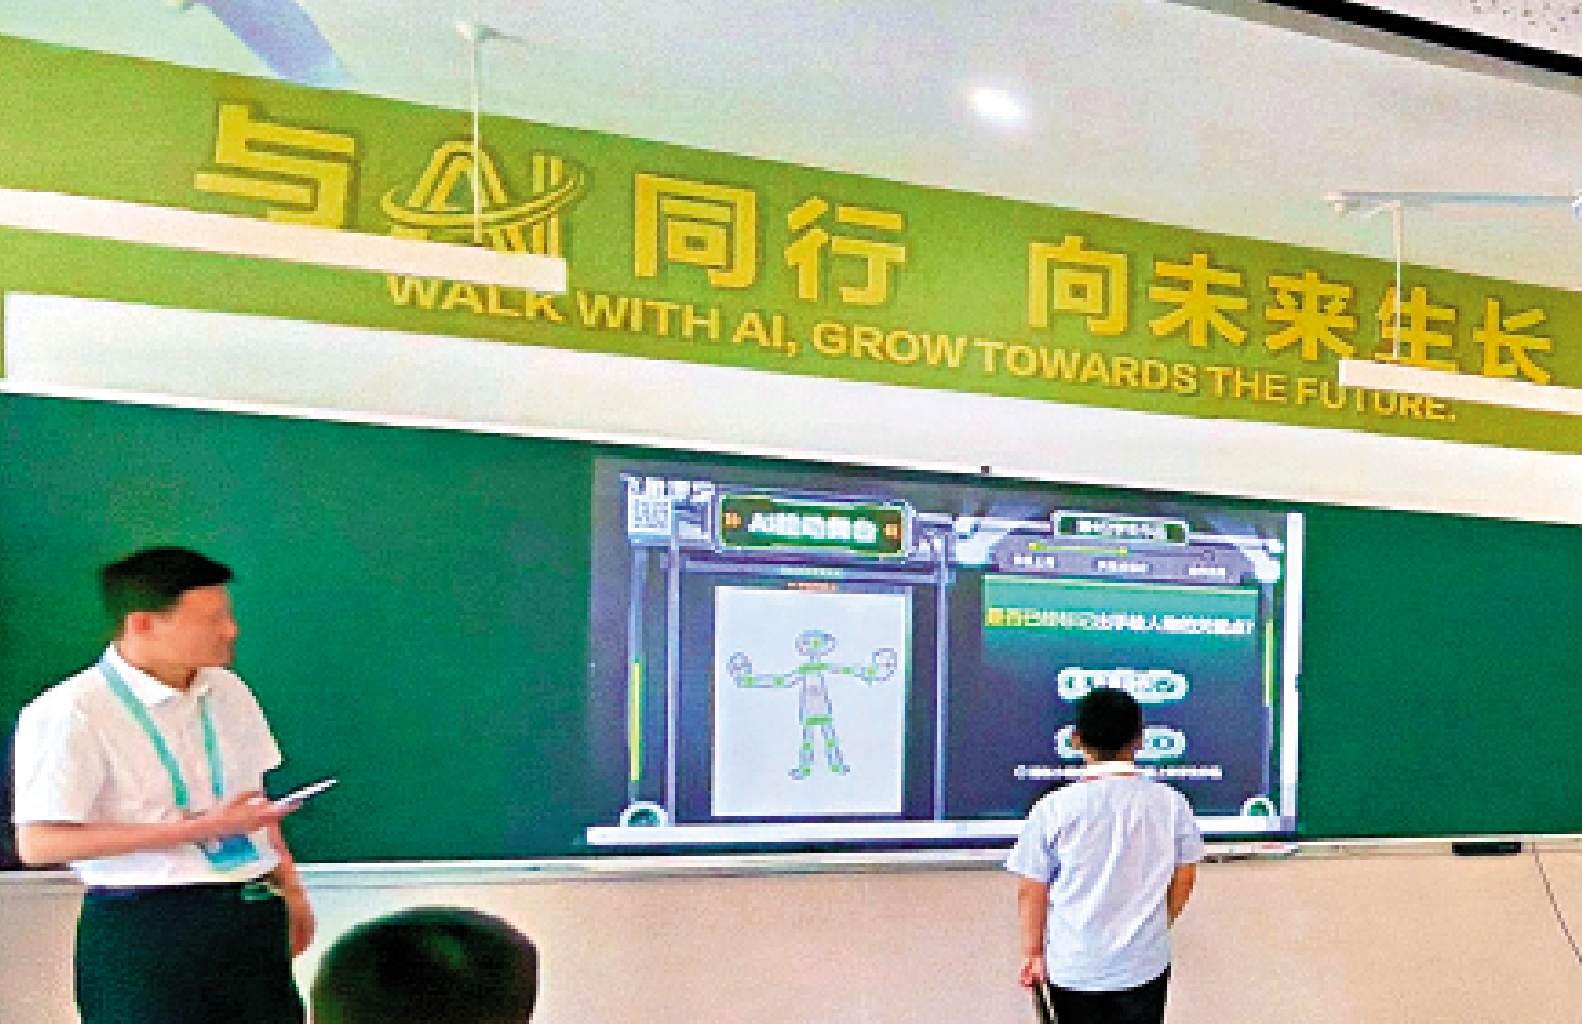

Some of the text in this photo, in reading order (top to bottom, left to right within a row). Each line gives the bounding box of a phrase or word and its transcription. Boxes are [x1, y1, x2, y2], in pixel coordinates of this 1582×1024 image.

[387, 276, 565, 324] WALK
[577, 289, 721, 340] WITH
[732, 310, 799, 359] AI,
[813, 321, 969, 370] GROW
[973, 336, 1198, 395] TOWARDS
[1206, 366, 1288, 402] THE
[1027, 235, 1553, 385] 向未来生长
